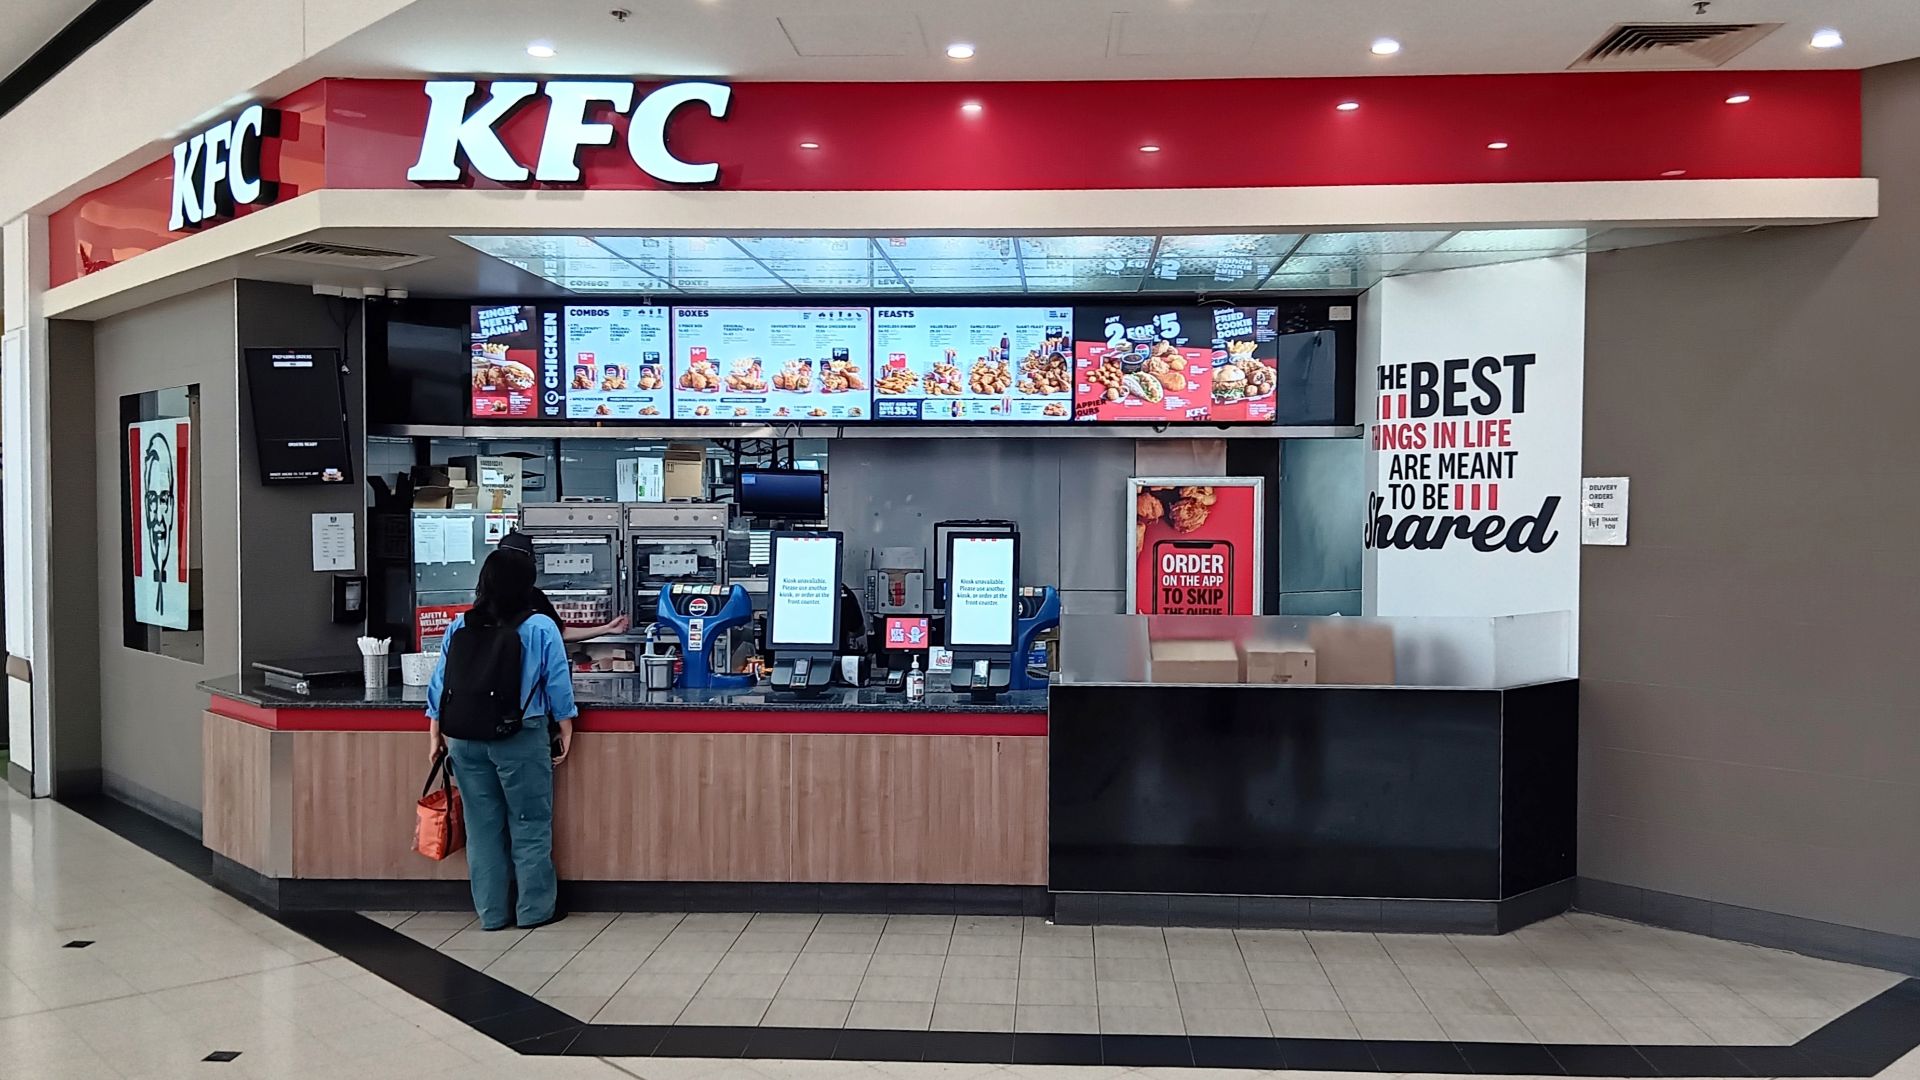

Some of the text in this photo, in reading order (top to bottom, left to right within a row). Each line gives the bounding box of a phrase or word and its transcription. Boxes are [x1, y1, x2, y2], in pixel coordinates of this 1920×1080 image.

[406, 81, 732, 185] KFC
[168, 105, 263, 232] KFC
[479, 314, 517, 329] MEETS
[570, 309, 610, 317] COMBOS
[878, 310, 914, 318] FEASTS
[1105, 315, 1120, 324] ANY
[1214, 312, 1244, 324] FRIED
[1104, 312, 1180, 349] 2 FOR $5
[1215, 318, 1253, 331] COOKIE
[1217, 325, 1253, 339] DOUGH
[544, 312, 558, 389] CHICKEN
[1410, 353, 1536, 418] BEST
[1186, 407, 1208, 418] KFC
[1433, 421, 1456, 449] IN
[1463, 418, 1511, 448] LIFE
[1389, 451, 1518, 480] ARE MEANT
[1388, 483, 1449, 510] TO BE
[1365, 490, 1562, 553] Shared
[1162, 554, 1224, 574] ORDER
[1162, 575, 1224, 586] ON THE APP
[1162, 588, 1224, 605] TO SKIP
[420, 611, 441, 619] SAFETY
